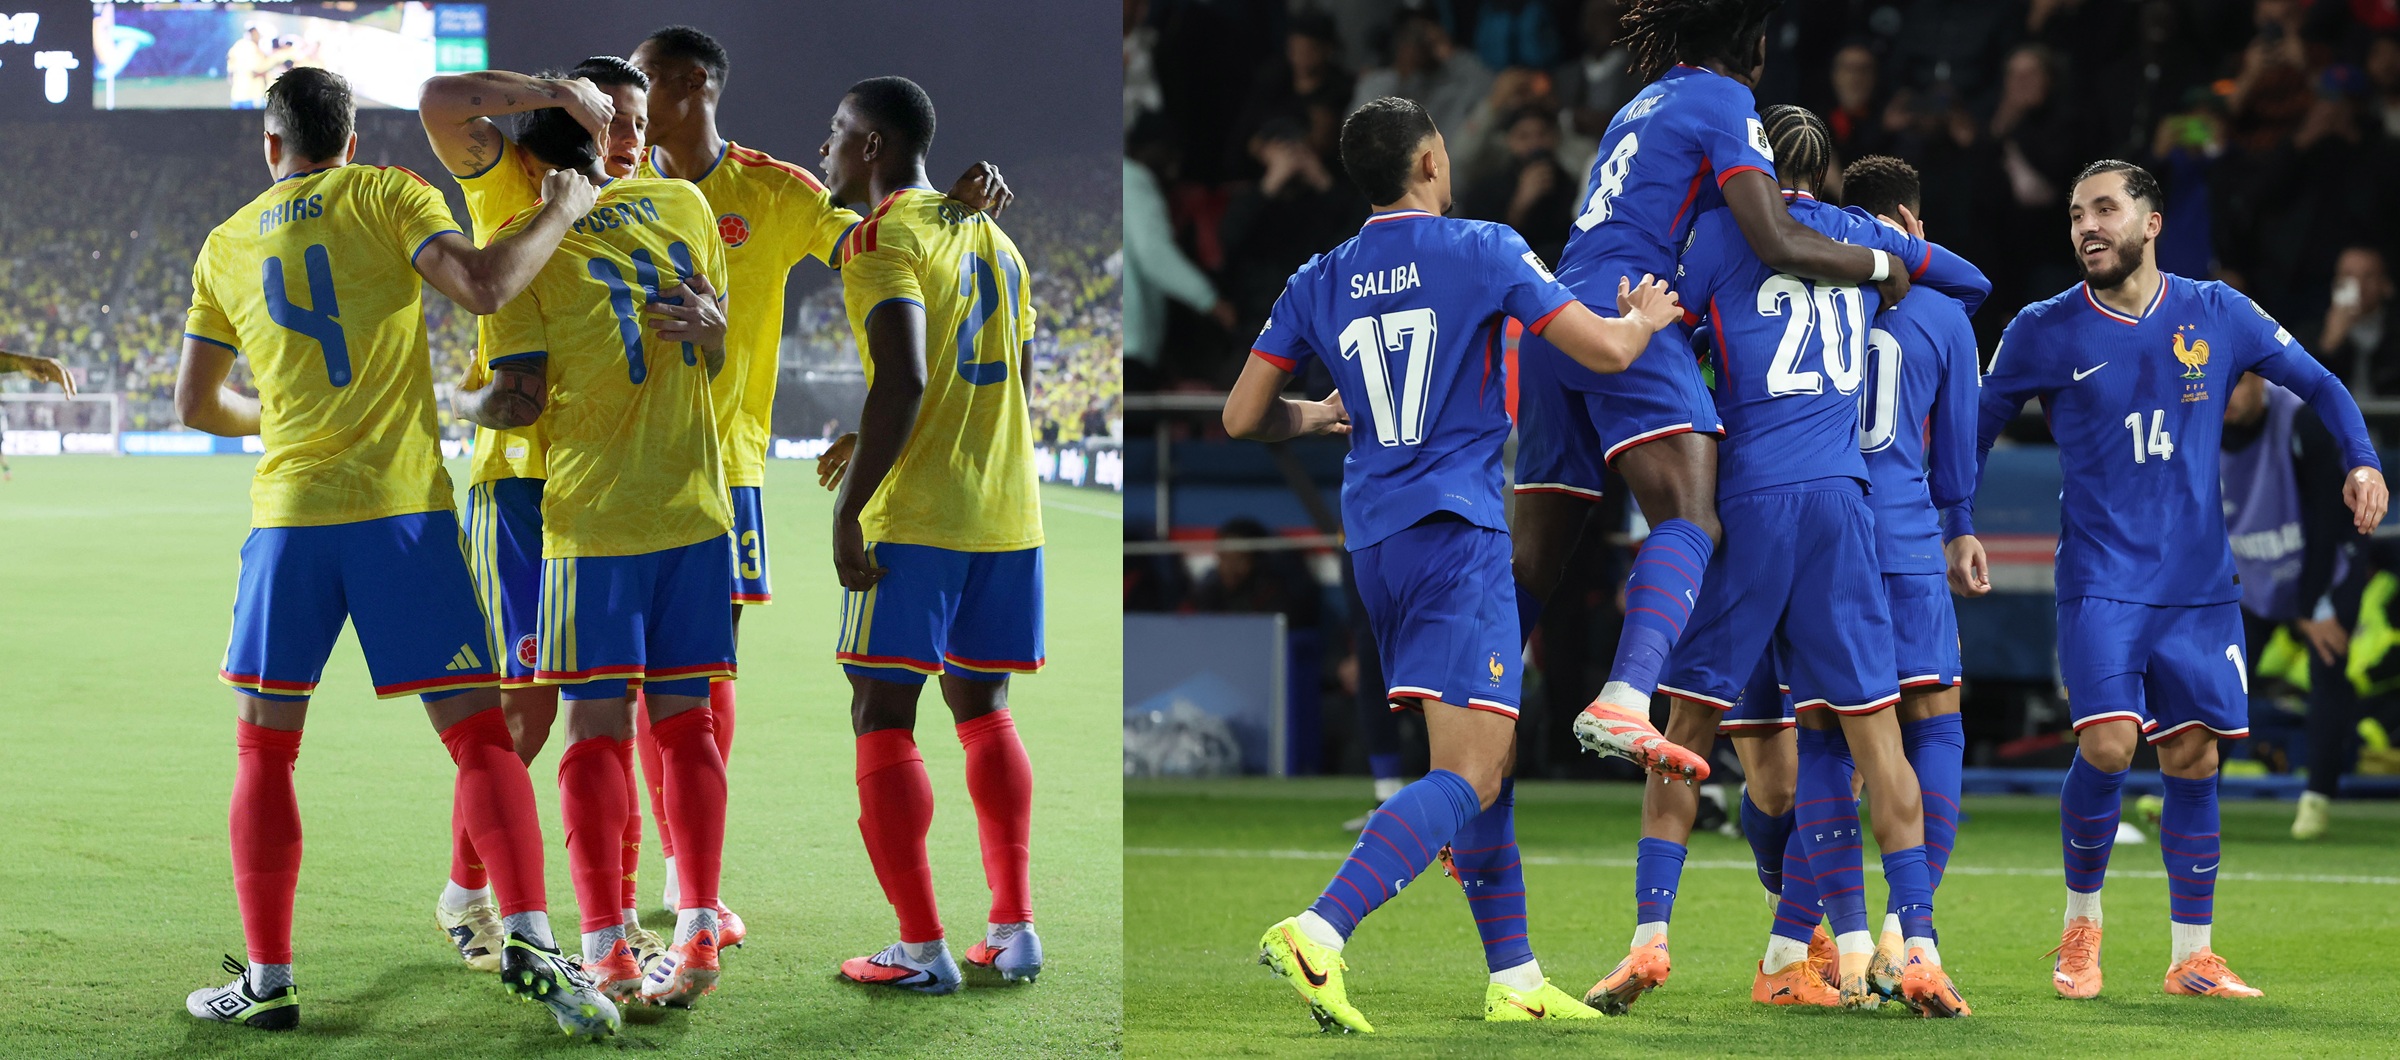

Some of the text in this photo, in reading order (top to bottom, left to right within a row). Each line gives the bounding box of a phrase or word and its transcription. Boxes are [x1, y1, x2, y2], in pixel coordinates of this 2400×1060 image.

[259, 194, 323, 235] ARIAS
[1575, 132, 1638, 233] 8
[262, 243, 352, 388] 4
[587, 241, 698, 385] 14
[957, 250, 1021, 386] 21
[1350, 262, 1421, 299] SALIBA
[1757, 273, 1865, 397] 20
[1338, 308, 1438, 447] 17
[2125, 409, 2174, 464] 14
[728, 529, 762, 580] 13
